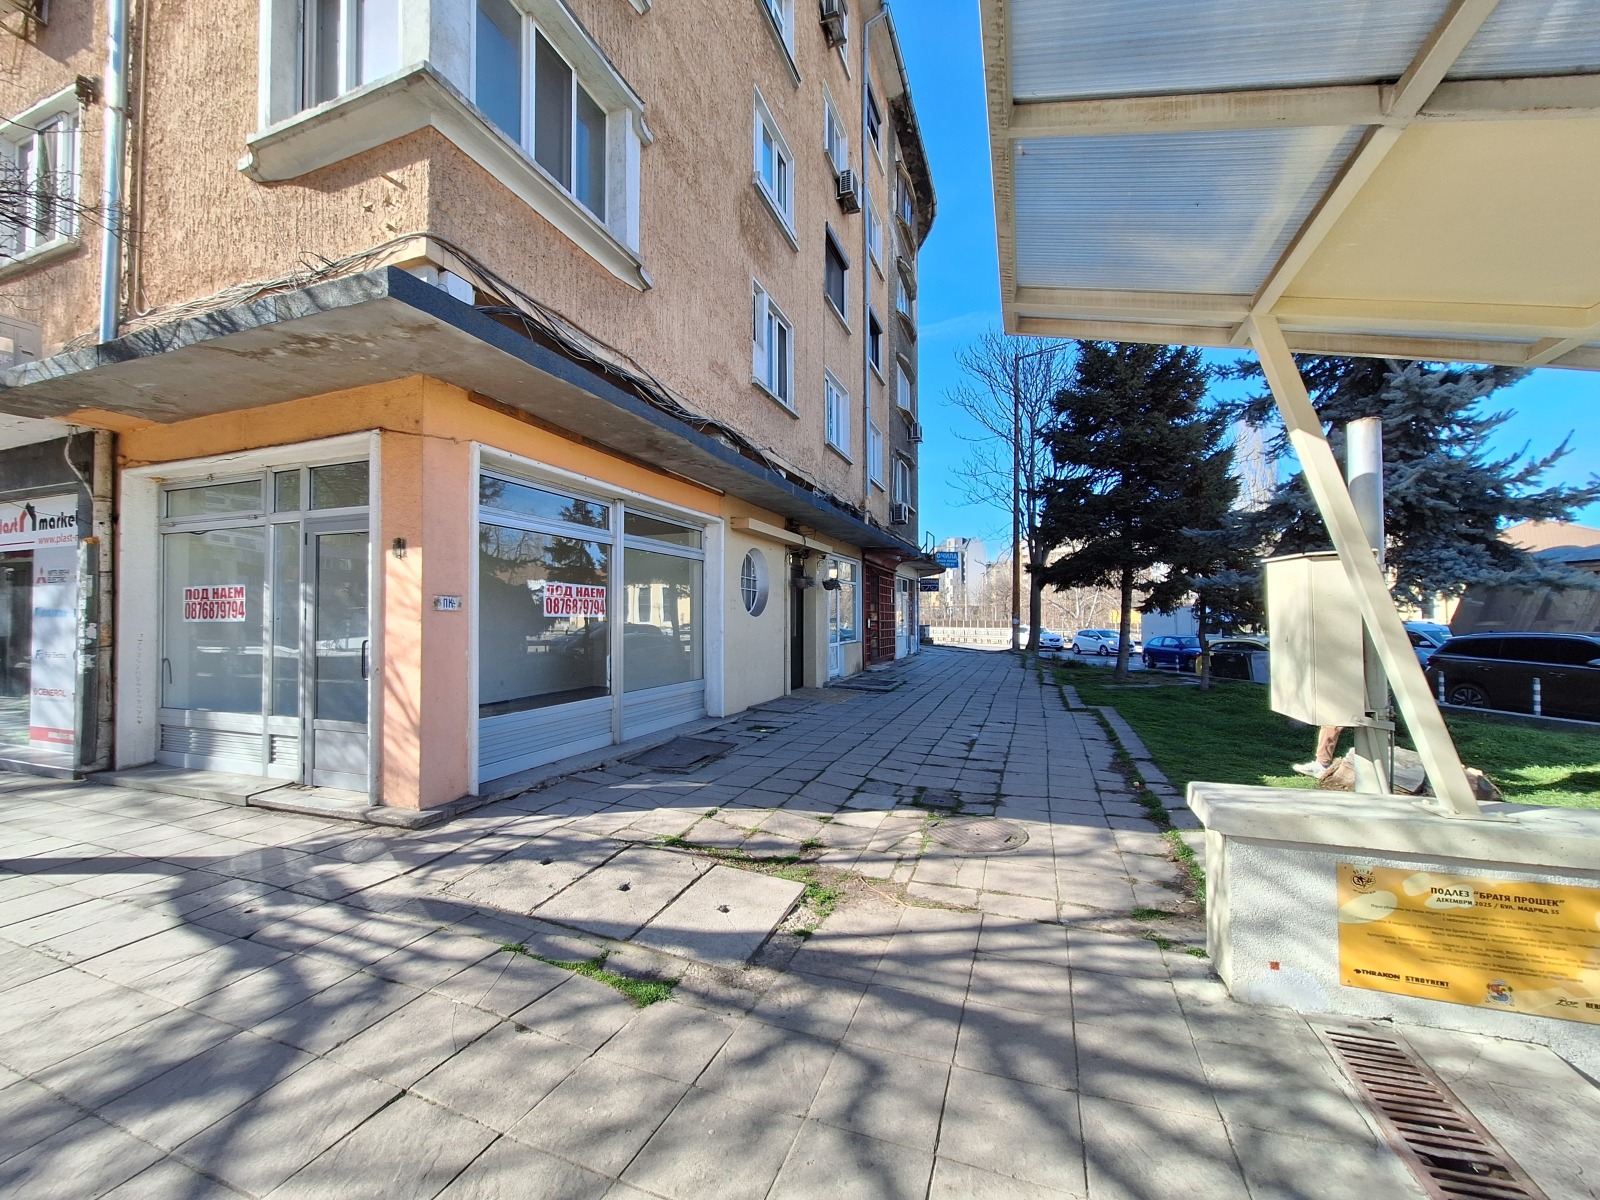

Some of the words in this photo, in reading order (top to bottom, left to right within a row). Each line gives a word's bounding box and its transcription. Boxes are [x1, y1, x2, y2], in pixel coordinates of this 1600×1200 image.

[185, 588, 209, 601] ПОД
[212, 587, 244, 599] НАЕМ
[576, 586, 605, 598] НАЕМ
[184, 601, 245, 619] 0876879794
[545, 597, 606, 615] 0876879794
[1430, 887, 1470, 897] ПОДЛЕЗ
[1436, 897, 1472, 906] ДЕКЕМВРИ
[1518, 906, 1549, 915] МАДРИД
